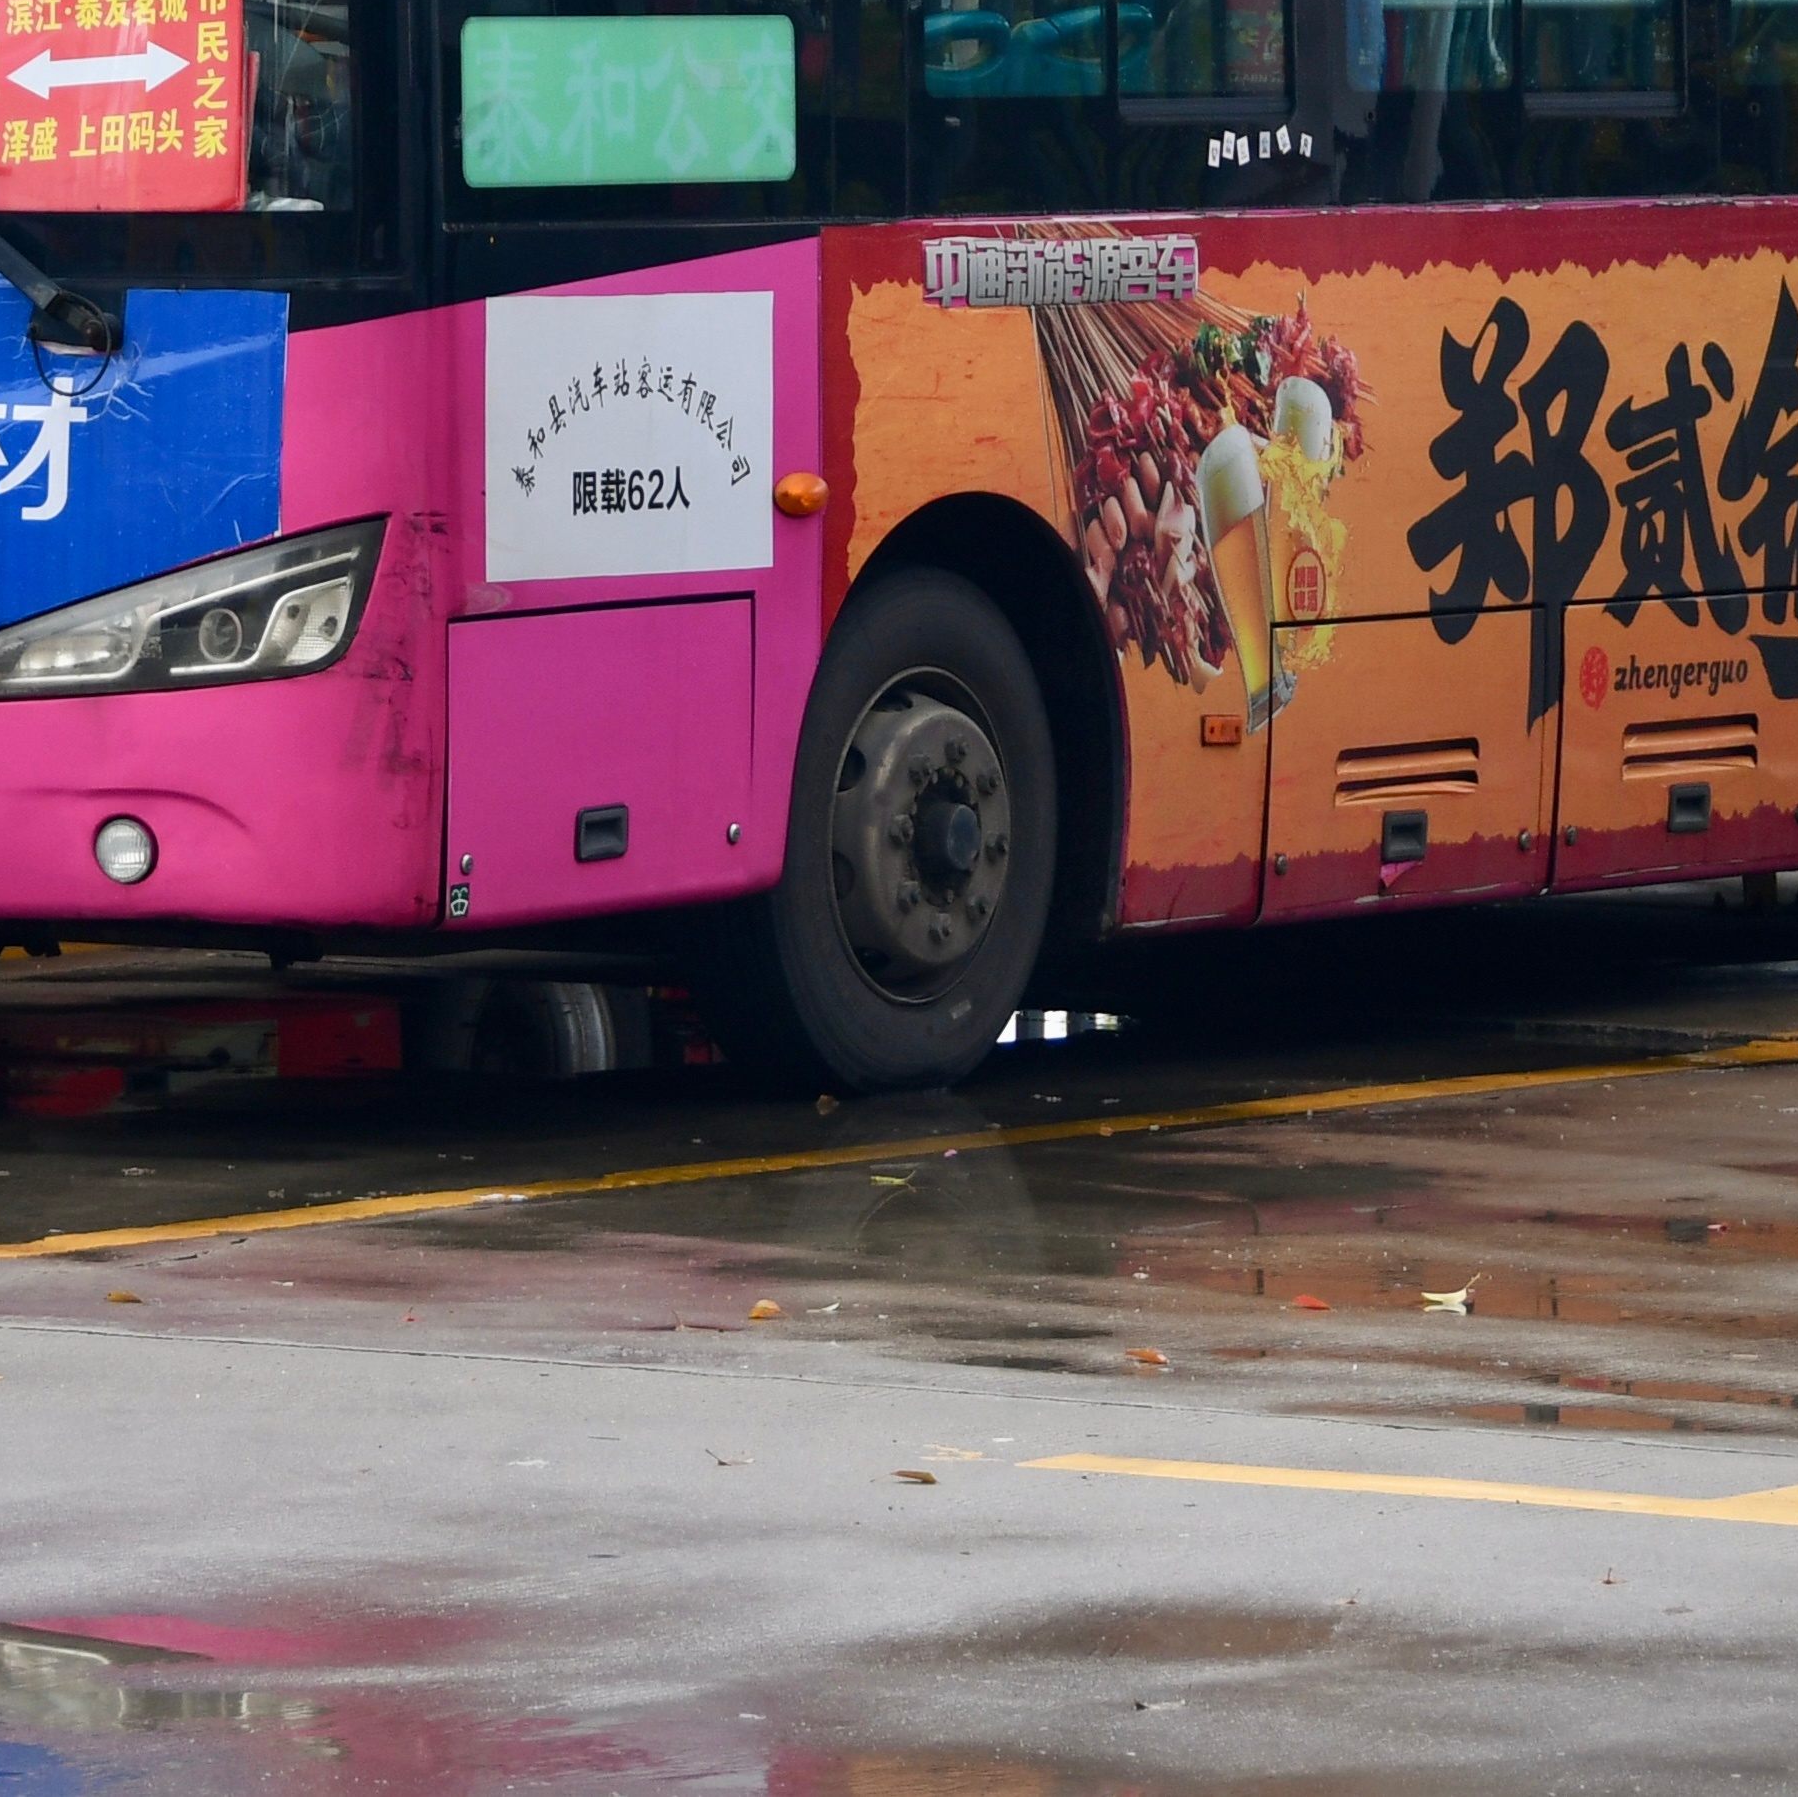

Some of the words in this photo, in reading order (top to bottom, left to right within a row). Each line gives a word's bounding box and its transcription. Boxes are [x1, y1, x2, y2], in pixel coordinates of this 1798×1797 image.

[1, 117, 59, 165] 泽盛
[70, 110, 184, 160] 上田码头
[464, 32, 796, 183] 泰和公交
[924, 235, 1199, 307] 中通新能源客车
[511, 356, 752, 497] 泰和县汽车站客运有限公司
[572, 466, 690, 516] 限载62人
[1614, 654, 1749, 699] zhengerguo
